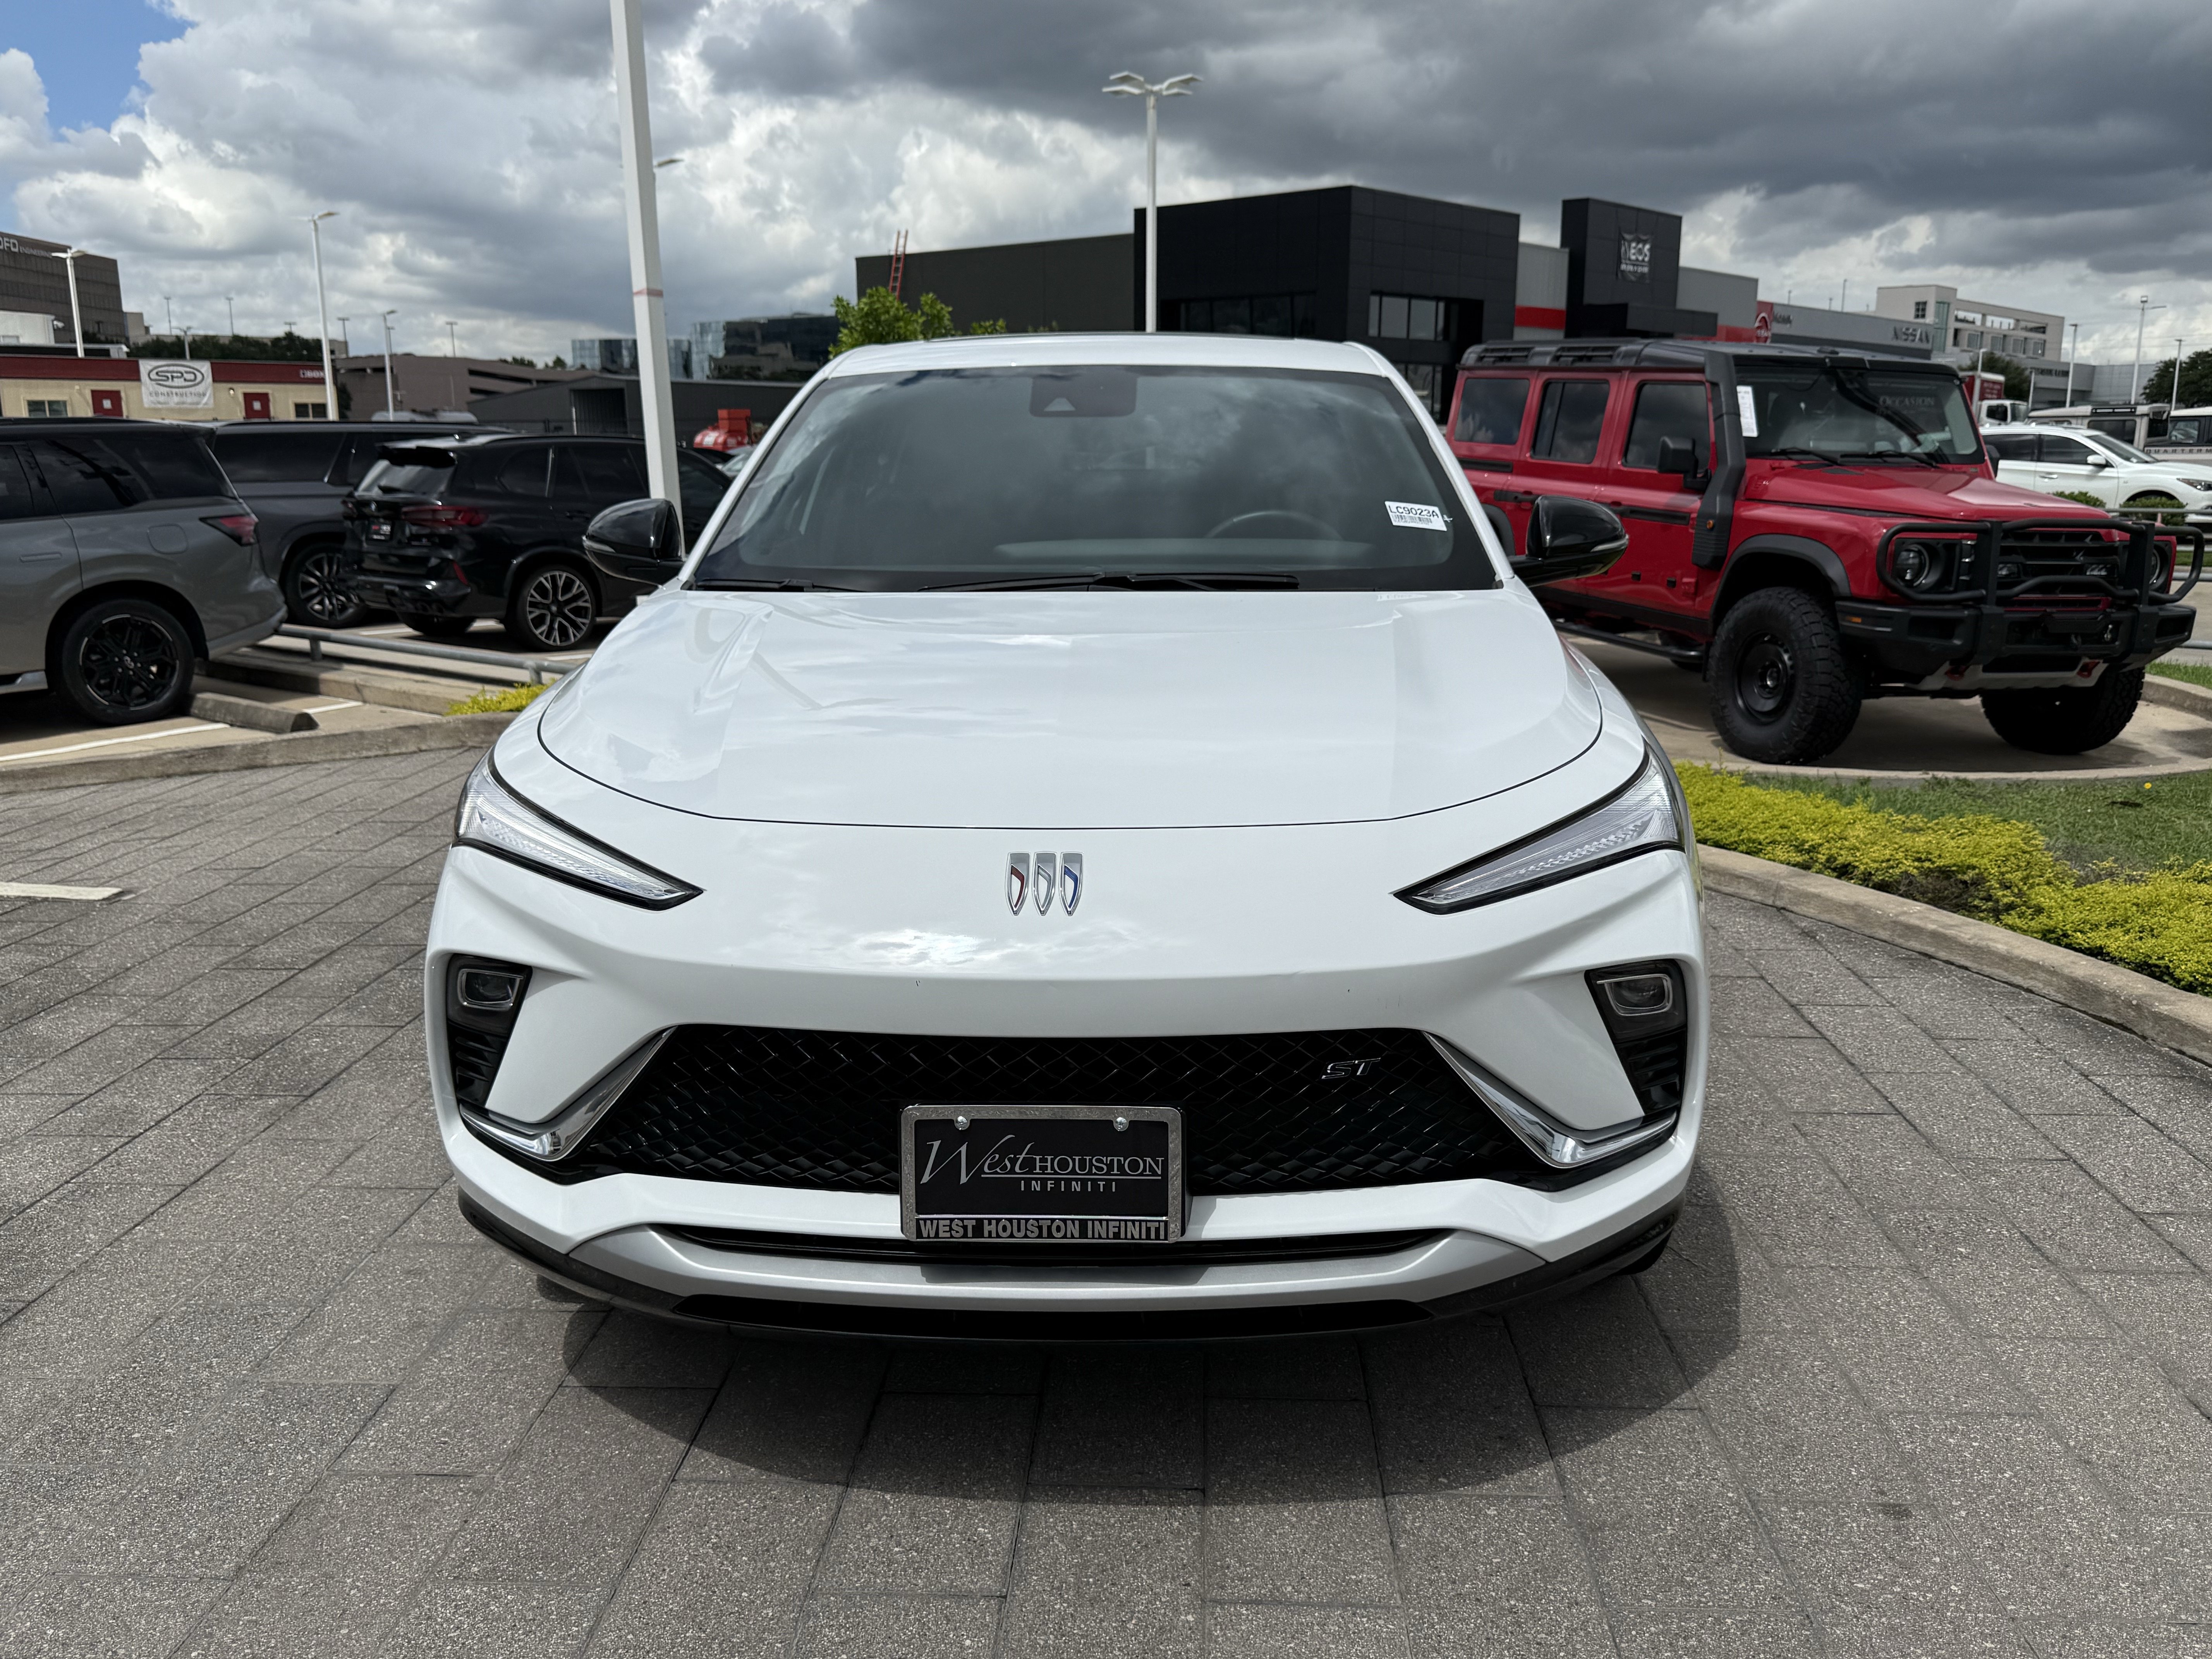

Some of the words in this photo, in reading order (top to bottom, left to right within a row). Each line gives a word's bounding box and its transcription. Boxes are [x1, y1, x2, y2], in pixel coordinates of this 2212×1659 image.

[1389, 505, 1439, 518] LC9023A
[1322, 1058, 1381, 1079] ST
[920, 1135, 1034, 1185] West
[1034, 1156, 1164, 1175] HOUSTON
[1021, 1180, 1116, 1192] INFINITI
[920, 1219, 975, 1238] WEST
[984, 1219, 1079, 1238] HOUSTON
[1087, 1221, 1165, 1240] INFINITI
